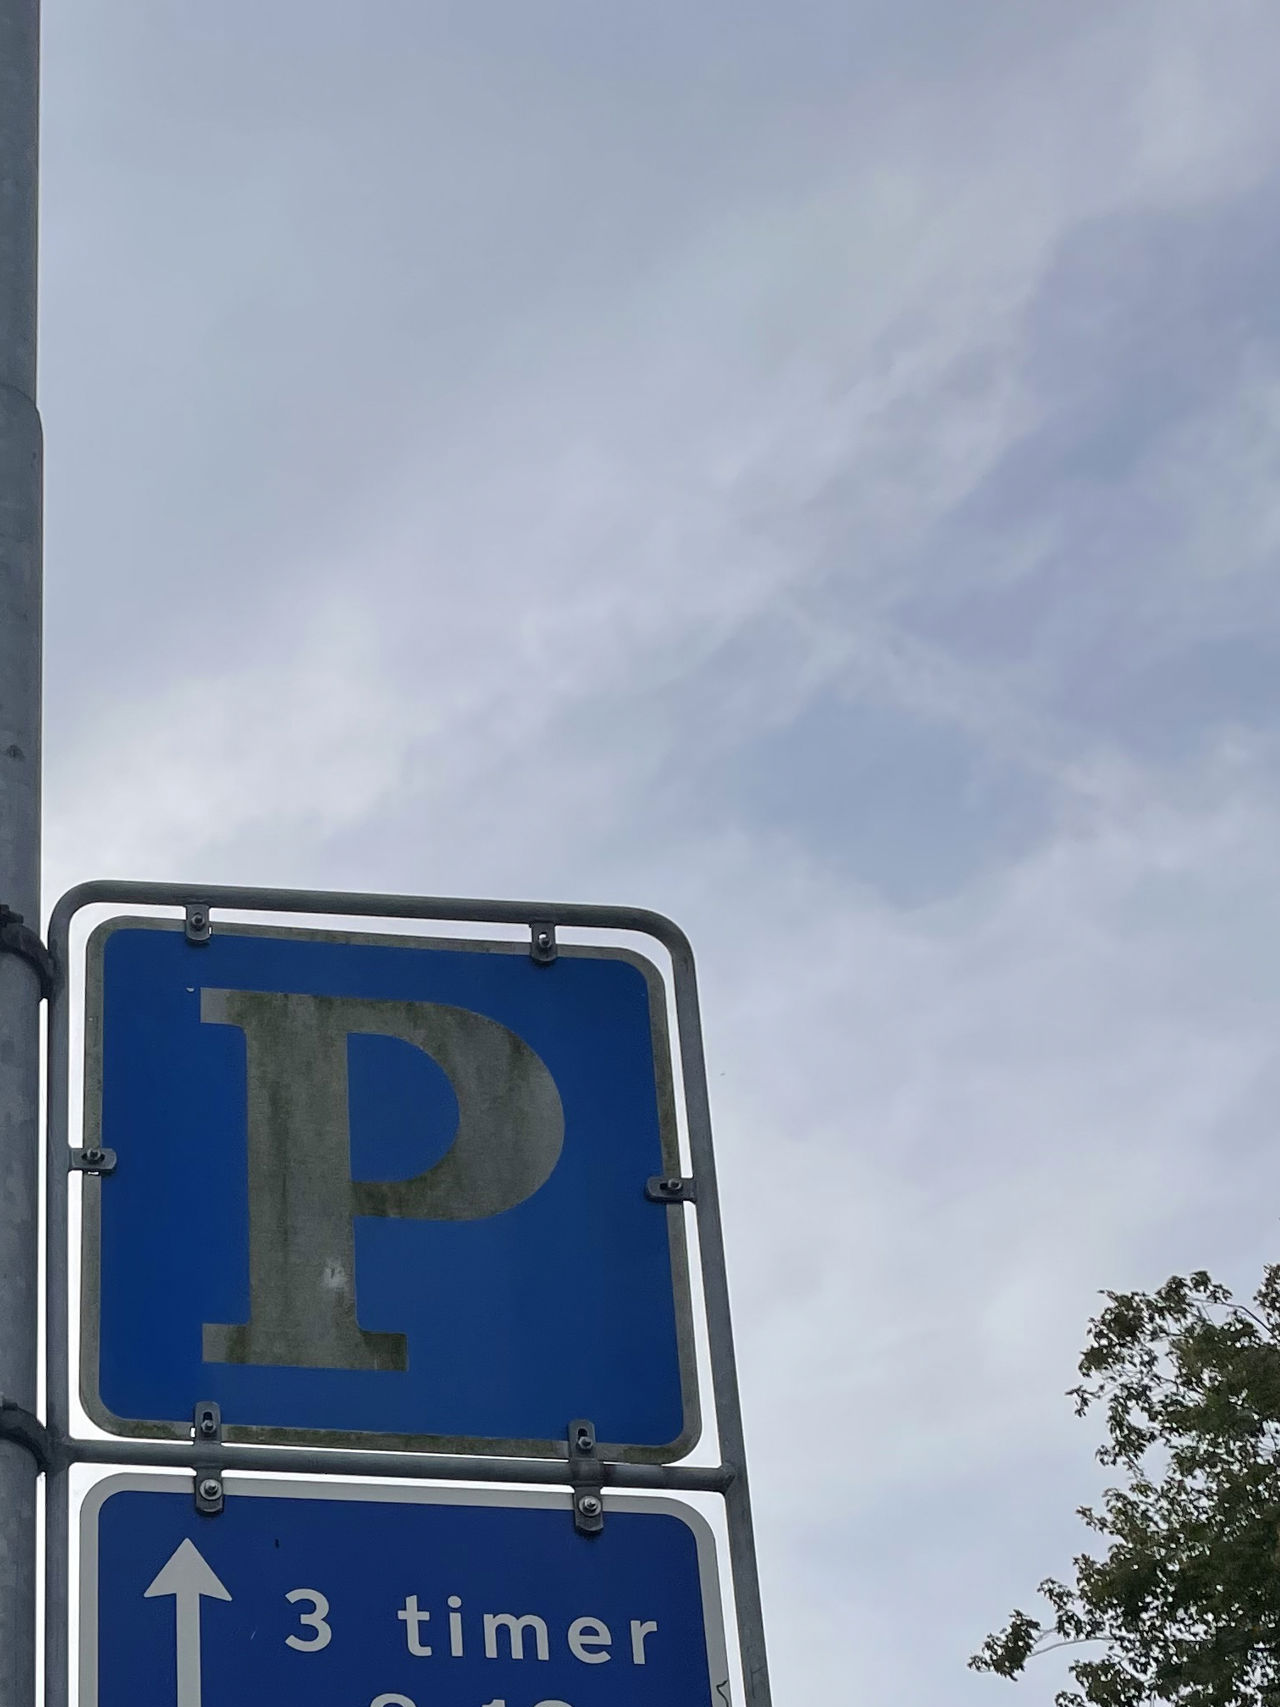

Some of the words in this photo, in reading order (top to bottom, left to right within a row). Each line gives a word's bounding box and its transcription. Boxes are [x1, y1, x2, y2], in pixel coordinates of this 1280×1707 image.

[200, 987, 565, 1373] P
[284, 1588, 333, 1653] 3
[396, 1594, 659, 1666] timer
